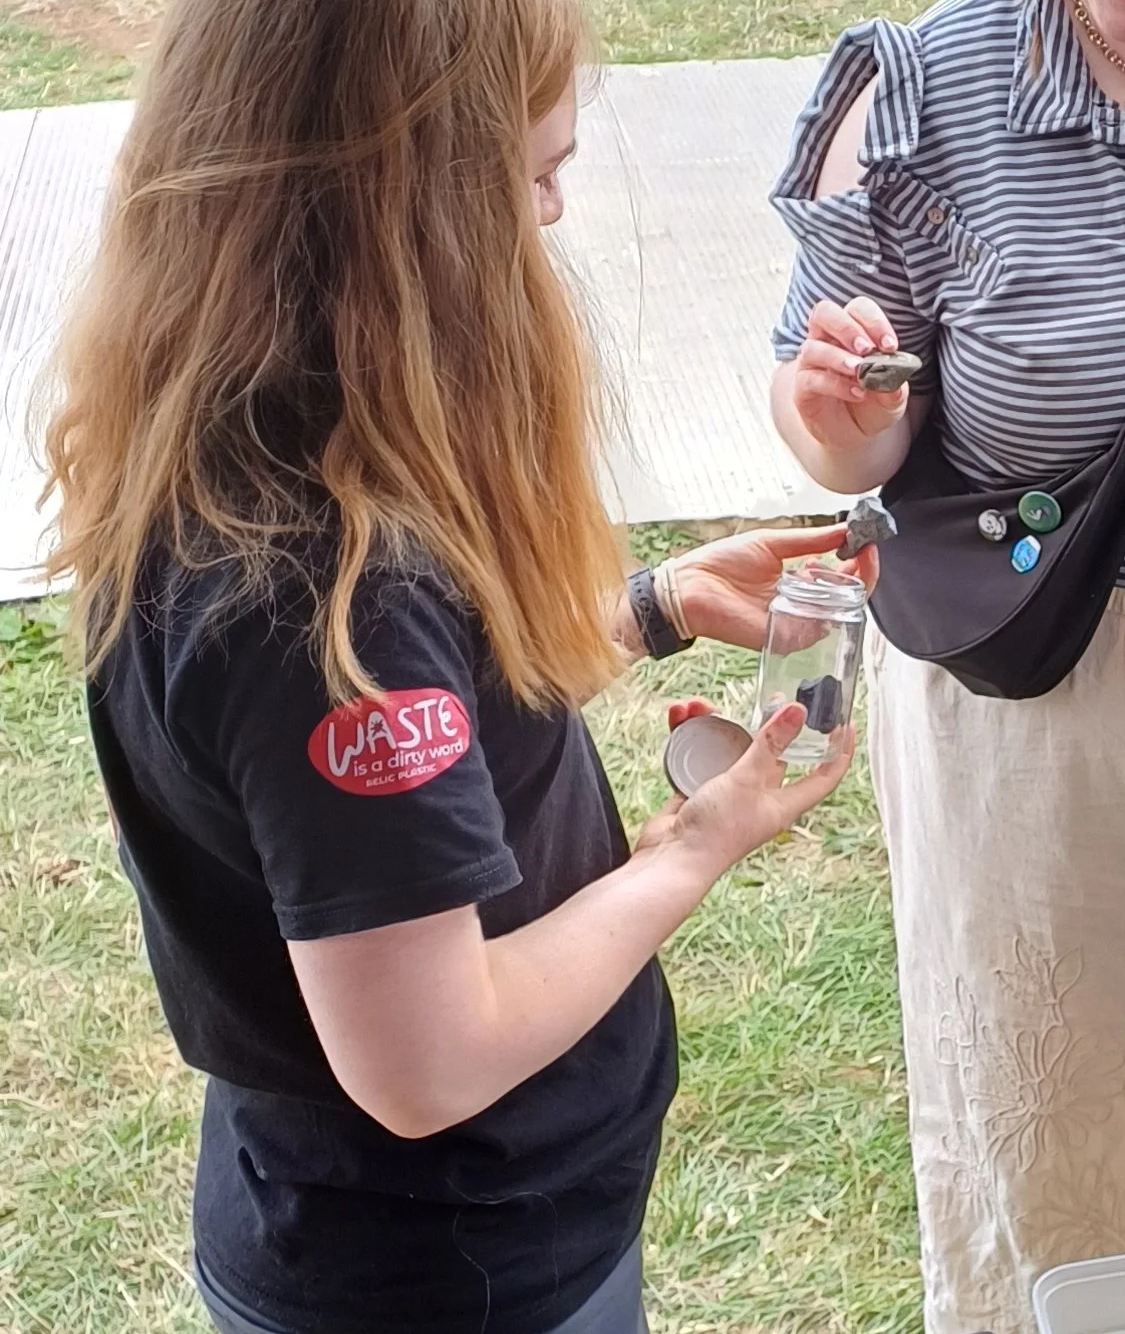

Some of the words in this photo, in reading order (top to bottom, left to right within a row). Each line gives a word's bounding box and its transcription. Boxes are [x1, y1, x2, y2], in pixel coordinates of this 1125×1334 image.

[327, 695, 458, 778] WASTE
[353, 761, 368, 778] is
[371, 759, 383, 773] a
[387, 748, 426, 769] dirty
[429, 738, 464, 758] word
